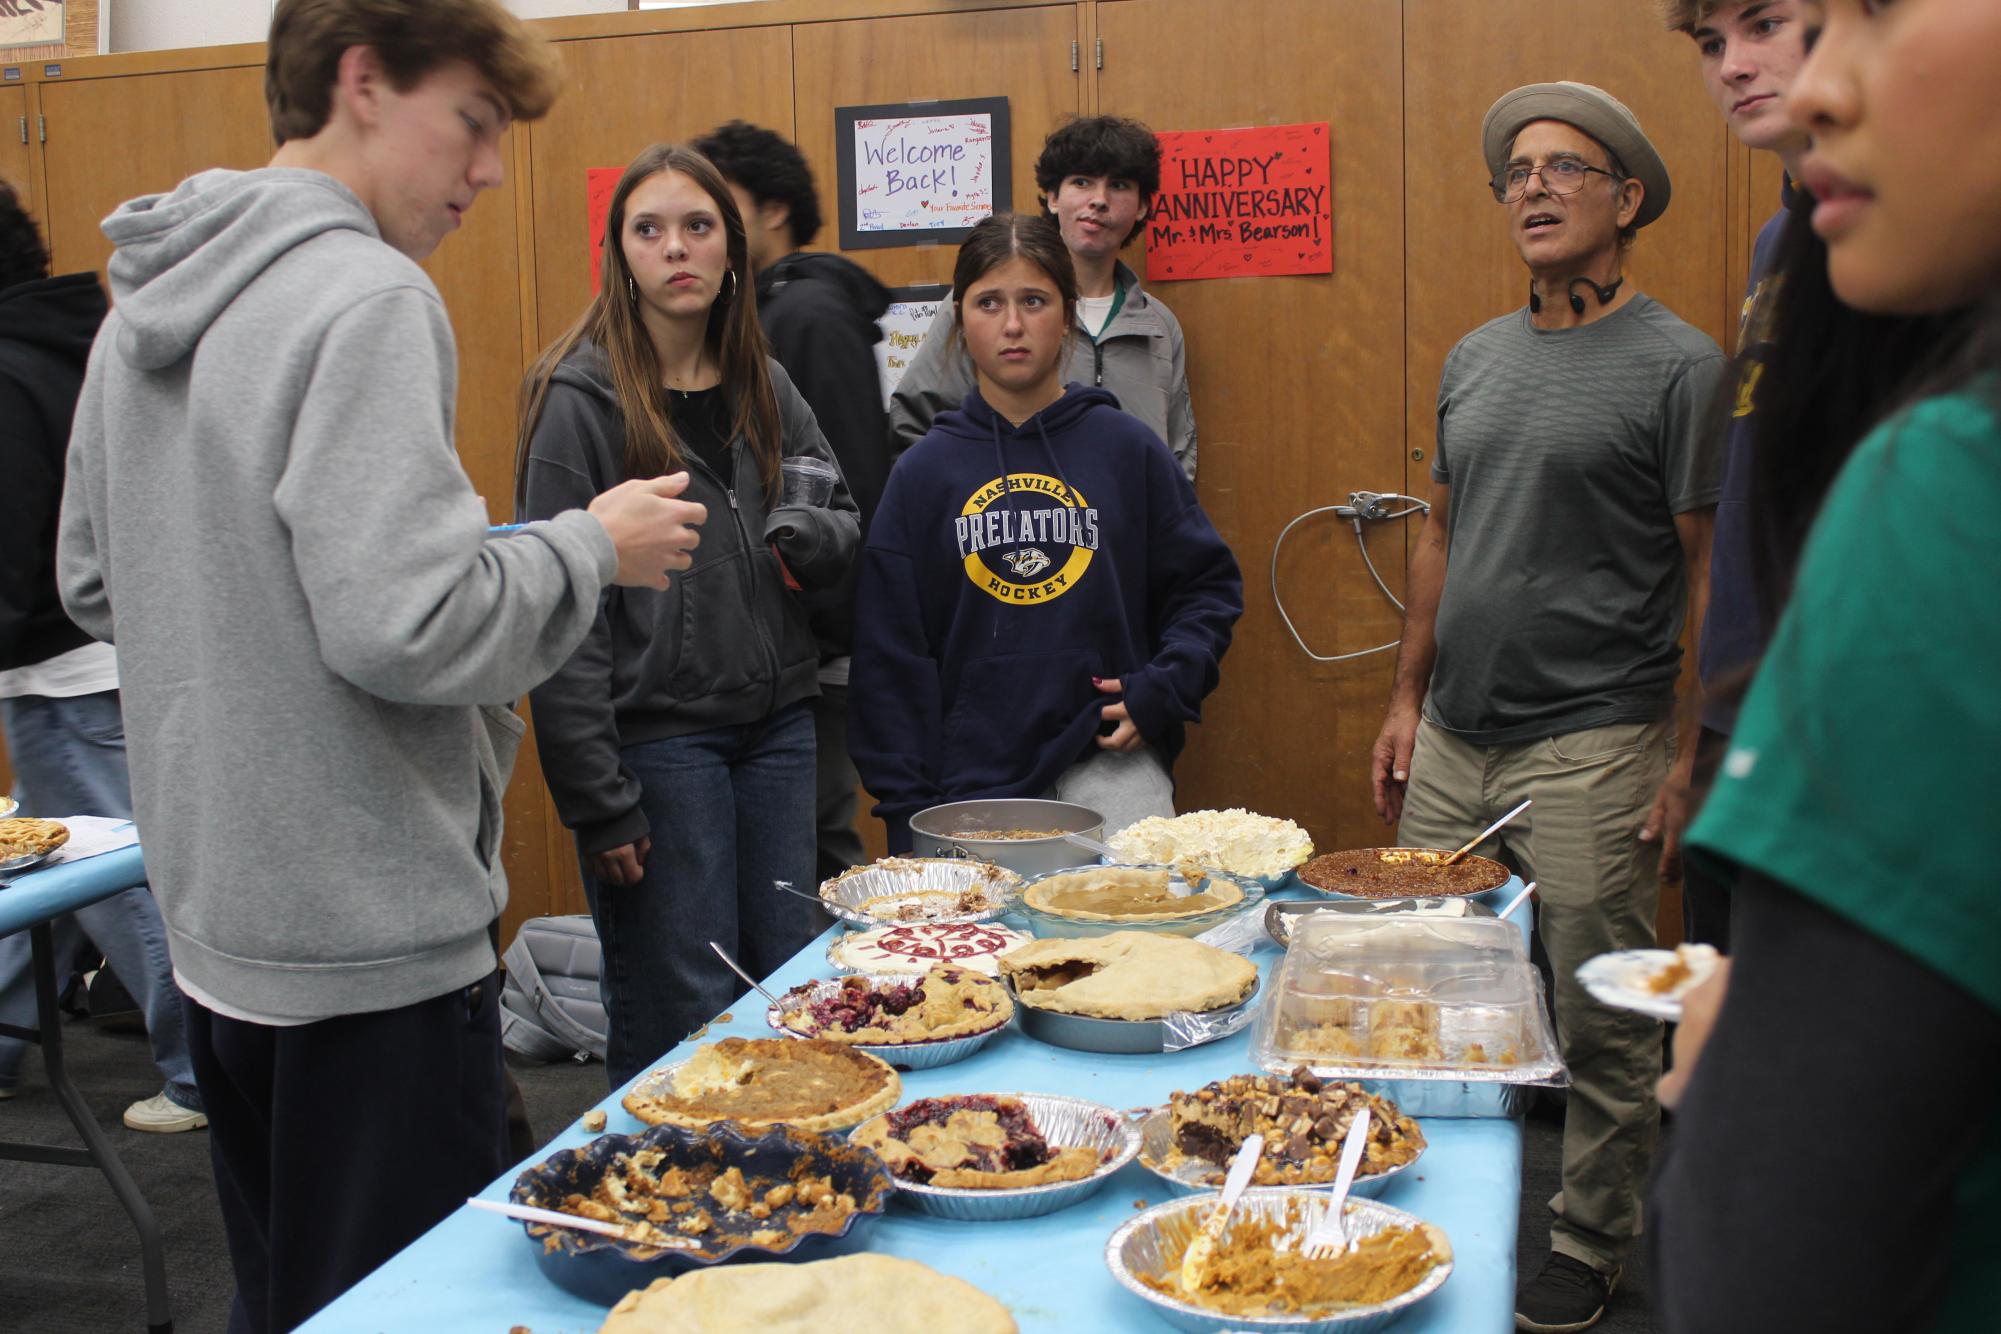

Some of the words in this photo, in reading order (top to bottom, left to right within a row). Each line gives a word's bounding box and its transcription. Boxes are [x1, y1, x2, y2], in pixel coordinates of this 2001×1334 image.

[864, 137, 966, 166] Welcome
[885, 165, 959, 198] Back!
[1181, 155, 1275, 189] HAPPY
[929, 204, 946, 214] Your
[1152, 184, 1327, 222] ANNIVERSARY
[1152, 225, 1187, 249] Mr.
[972, 477, 1074, 509] NASHVILLE
[988, 573, 1068, 600] HOCKEY
